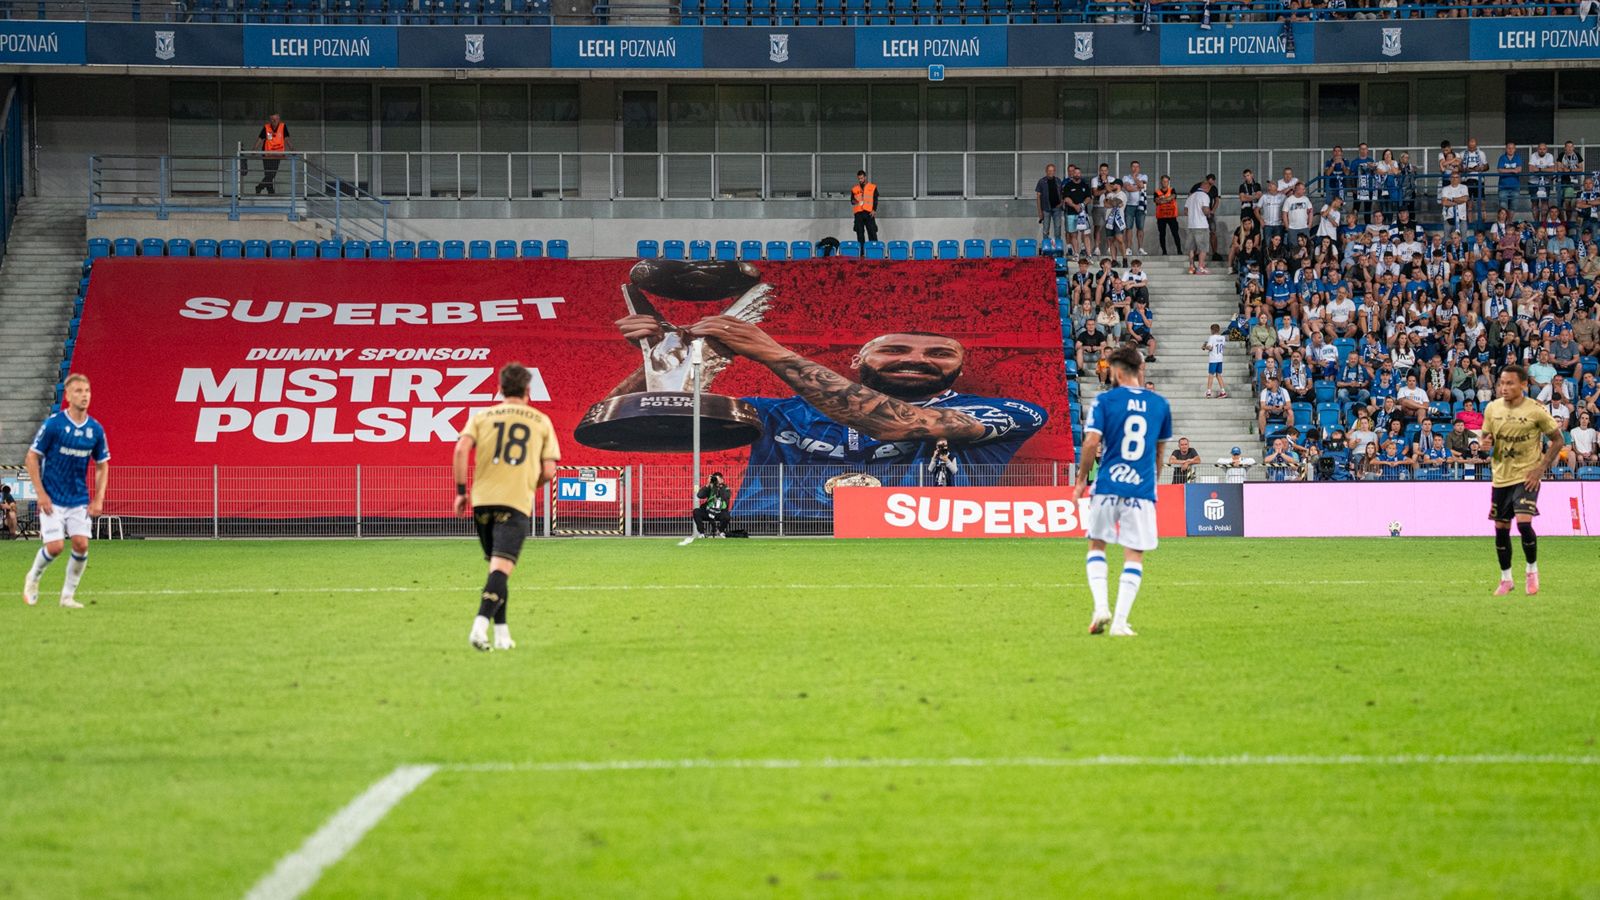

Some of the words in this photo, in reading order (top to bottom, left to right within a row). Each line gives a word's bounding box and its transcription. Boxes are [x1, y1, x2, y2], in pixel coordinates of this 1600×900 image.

[0, 32, 58, 53] POZNAŃ
[271, 38, 308, 56] LECH
[314, 36, 370, 57] POZNAŃ
[579, 39, 615, 57] LECH
[620, 37, 676, 57] POZNAŃ
[883, 39, 919, 57] LECH
[924, 37, 980, 57] POZNAŃ
[1188, 37, 1224, 54] LECH
[1498, 31, 1536, 49] LECH
[1541, 27, 1600, 48] POZNAŃ
[179, 296, 566, 326] SUPERBET
[245, 348, 355, 361] DUMNY
[358, 348, 492, 361] SPONSOR
[175, 367, 552, 402] MISTRZA
[1127, 399, 1147, 412] ALI
[194, 406, 484, 443] POLSK
[492, 421, 531, 466] 18
[1121, 414, 1148, 461] 8
[562, 482, 581, 497] M
[594, 483, 608, 496] 9
[884, 493, 1091, 534] SUPERB
